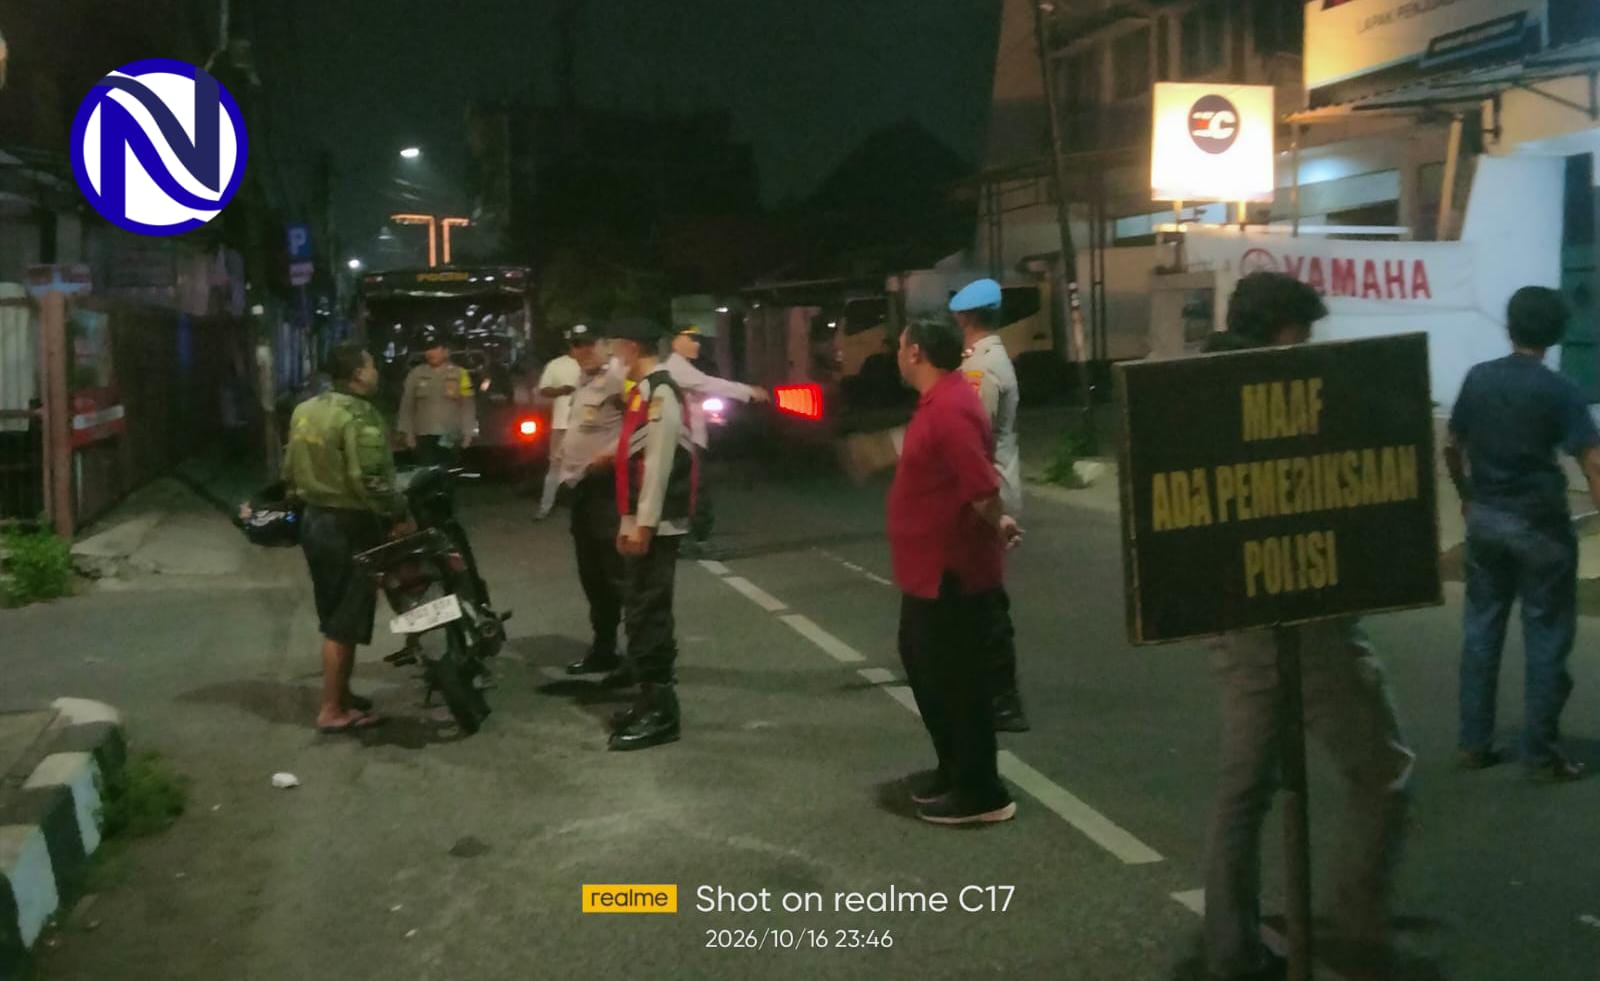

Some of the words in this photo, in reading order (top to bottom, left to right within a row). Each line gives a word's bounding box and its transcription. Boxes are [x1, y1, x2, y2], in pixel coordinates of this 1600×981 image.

[1241, 376, 1324, 442] MAAF
[1151, 467, 1213, 532] ADA
[1214, 444, 1419, 523] PEMERIKSAAN
[1243, 530, 1339, 598] POLISI
